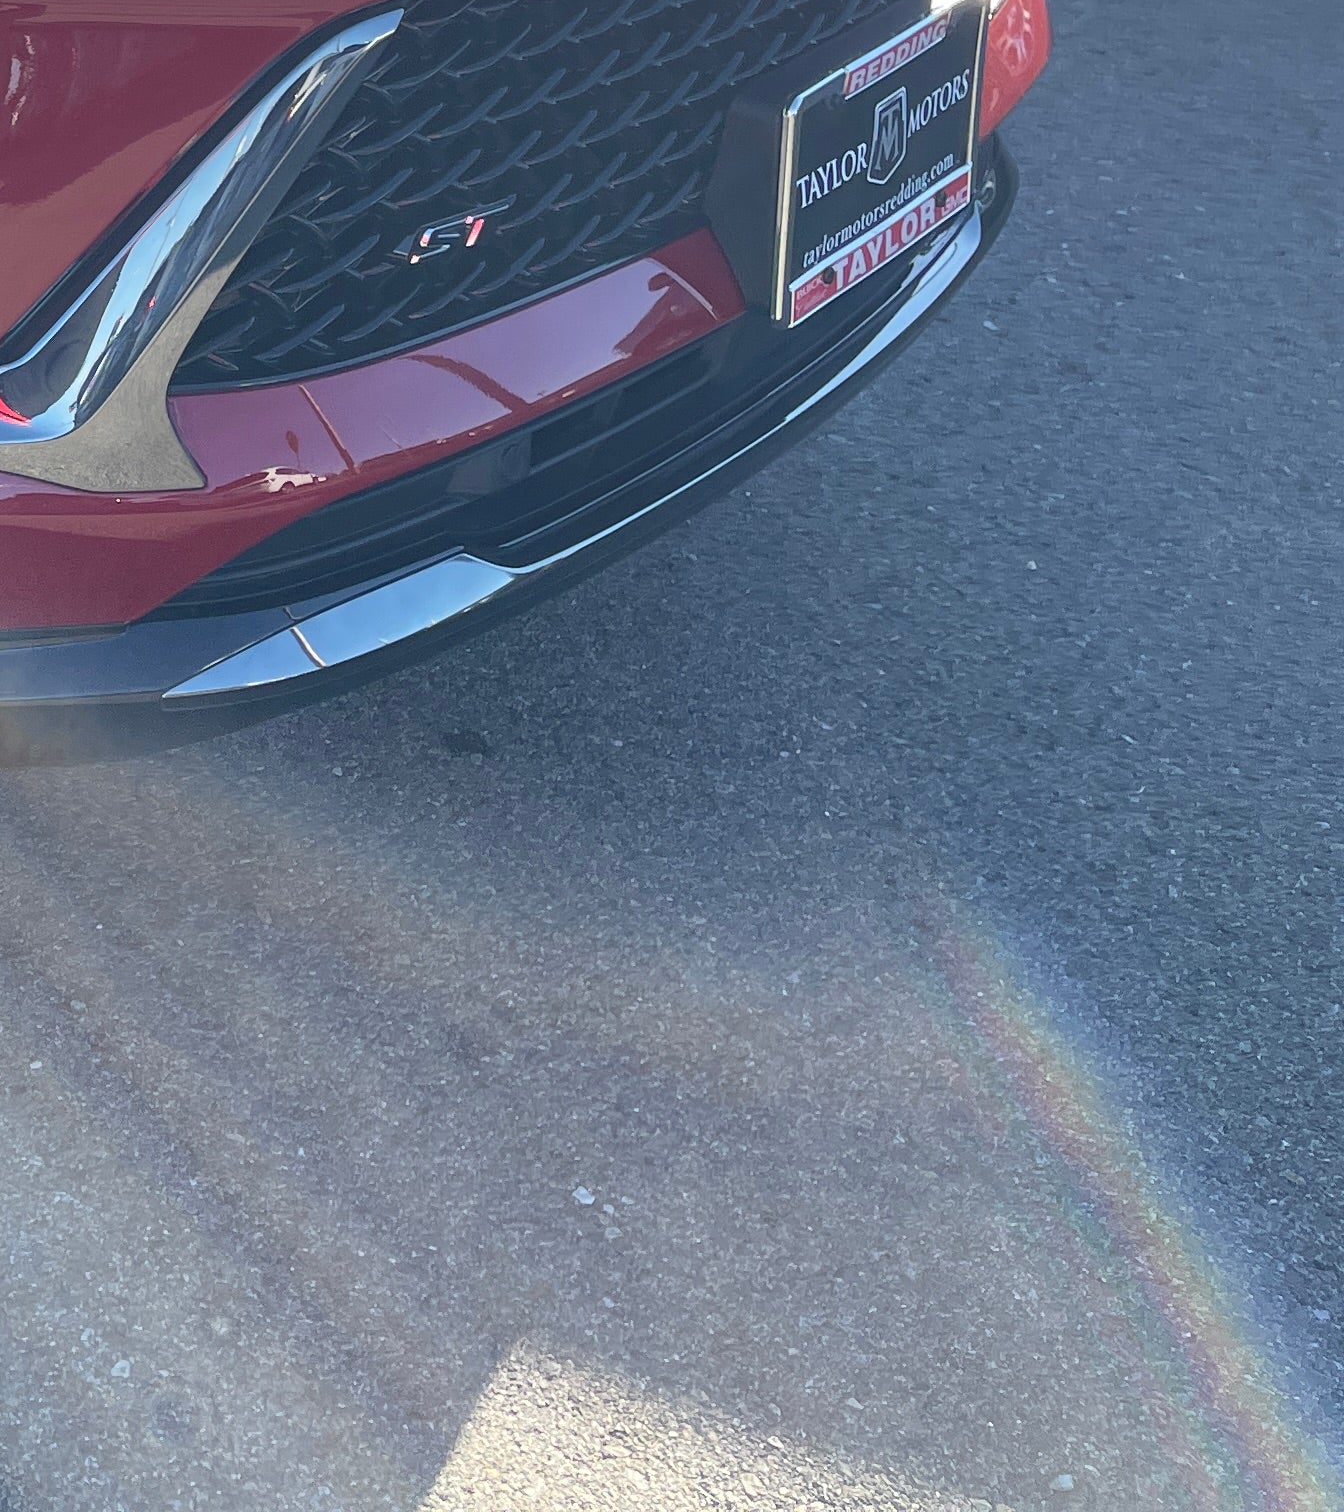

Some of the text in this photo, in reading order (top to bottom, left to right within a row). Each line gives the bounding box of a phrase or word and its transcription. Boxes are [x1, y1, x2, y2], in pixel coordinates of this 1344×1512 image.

[849, 18, 948, 94] REDDING
[796, 142, 869, 209] TAYLOR
[907, 68, 970, 138] MOTORS
[802, 153, 954, 269] taylormotorsredding.com
[831, 197, 936, 291] TAYLOR
